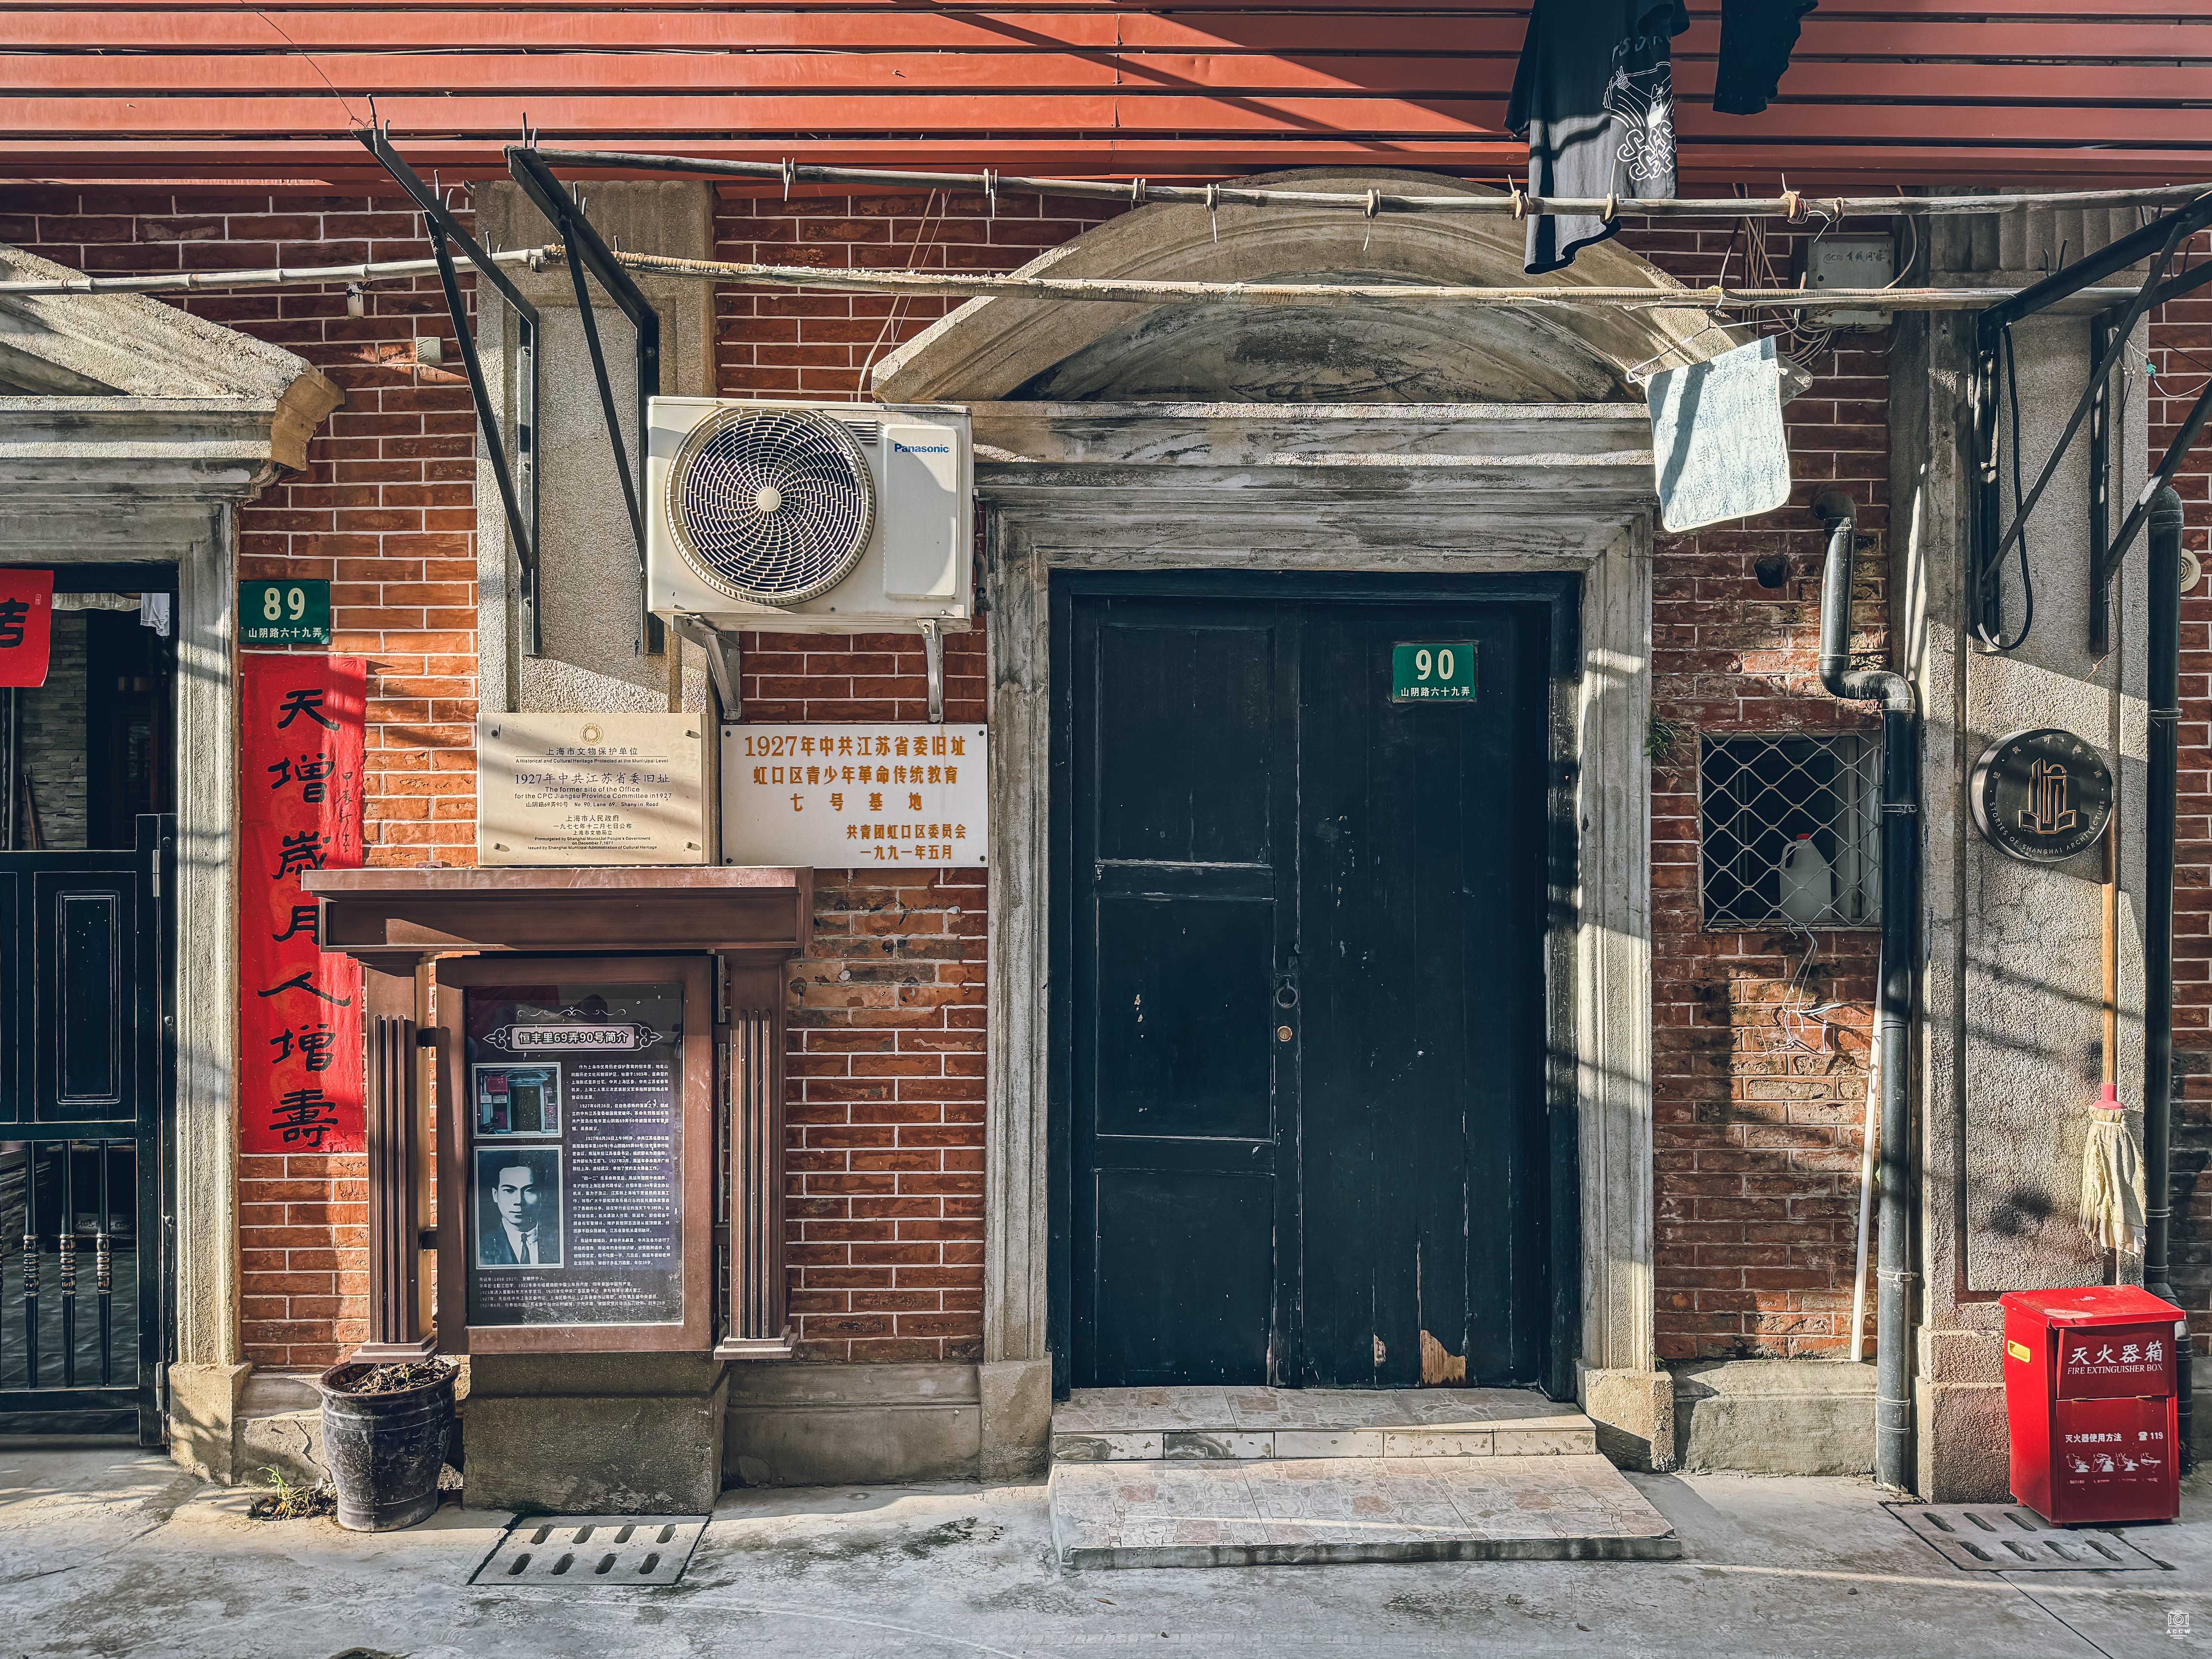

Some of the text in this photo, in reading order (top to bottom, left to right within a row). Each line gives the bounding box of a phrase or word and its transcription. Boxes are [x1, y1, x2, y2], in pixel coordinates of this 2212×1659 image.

[894, 443, 949, 453] Panasonic
[264, 587, 305, 620] 89
[248, 627, 322, 638] 山阴路六十九弄
[1415, 649, 1454, 680] 90
[1401, 687, 1470, 697] 山阴路六十九弄
[745, 736, 966, 757] 1927年中共江苏省委旧址
[515, 773, 670, 785] 1927年中共江苏省委旧址
[754, 766, 958, 785] 虹口区青少年革命传统教育
[846, 824, 966, 840] 共青团虹口区委员会
[1989, 800, 2105, 854] STORIES OF SHANGHAI ARCHITECTURE
[860, 844, 952, 860] 一九九一年五月
[519, 1031, 628, 1044] 恒丰里69弄90号简介
[2068, 1340, 2163, 1365] 灭火器箱
[2087, 1365, 2145, 1374] EXTINGUISHER
[2065, 1433, 2122, 1443] 灭火器使用方法
